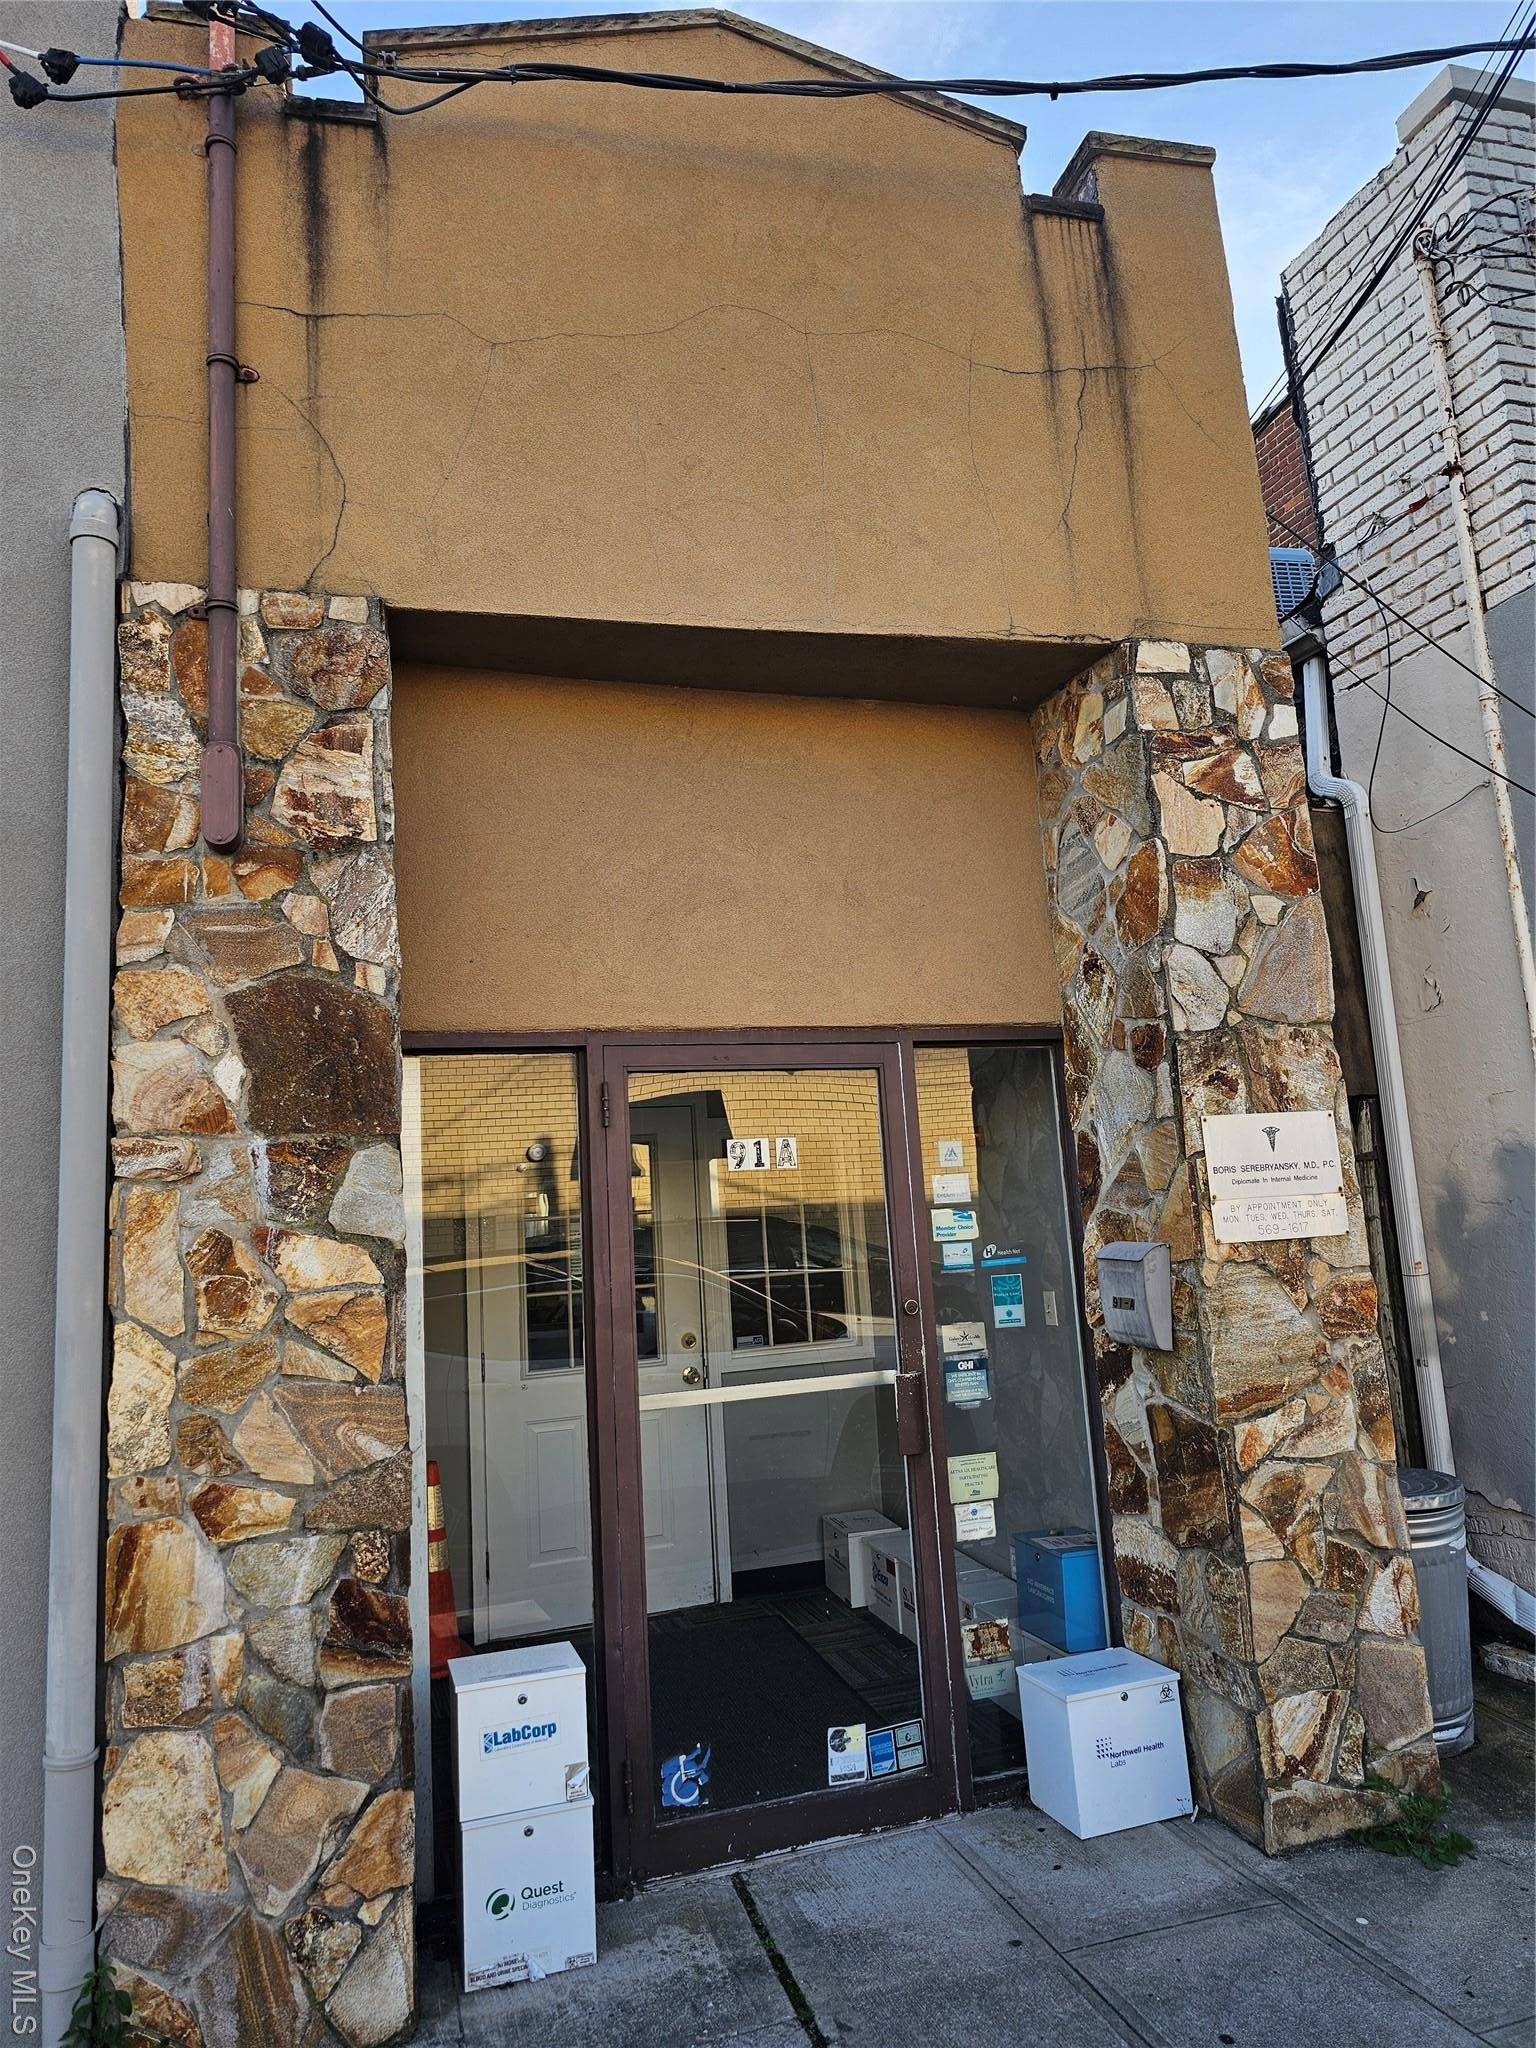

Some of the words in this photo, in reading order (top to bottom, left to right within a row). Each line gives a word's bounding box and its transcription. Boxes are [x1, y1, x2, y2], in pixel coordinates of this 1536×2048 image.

[1213, 1165, 1237, 1174] BORIS
[1231, 1177, 1260, 1185] Diplomate
[1230, 1204, 1240, 1213] BY
[1247, 1201, 1302, 1212] APPOINTMENT
[1307, 1199, 1328, 1208] ONLY
[1258, 1221, 1309, 1235] 569-1617
[957, 1361, 974, 1371] GHI
[968, 1674, 993, 1689] Vytra
[493, 1722, 557, 1747] LabCorp
[1110, 1745, 1142, 1760] Northwell
[1143, 1741, 1165, 1753] Health
[1110, 1760, 1127, 1769] Labs
[521, 1881, 564, 1900] Quest
[522, 1893, 575, 1911] Diagnostics
